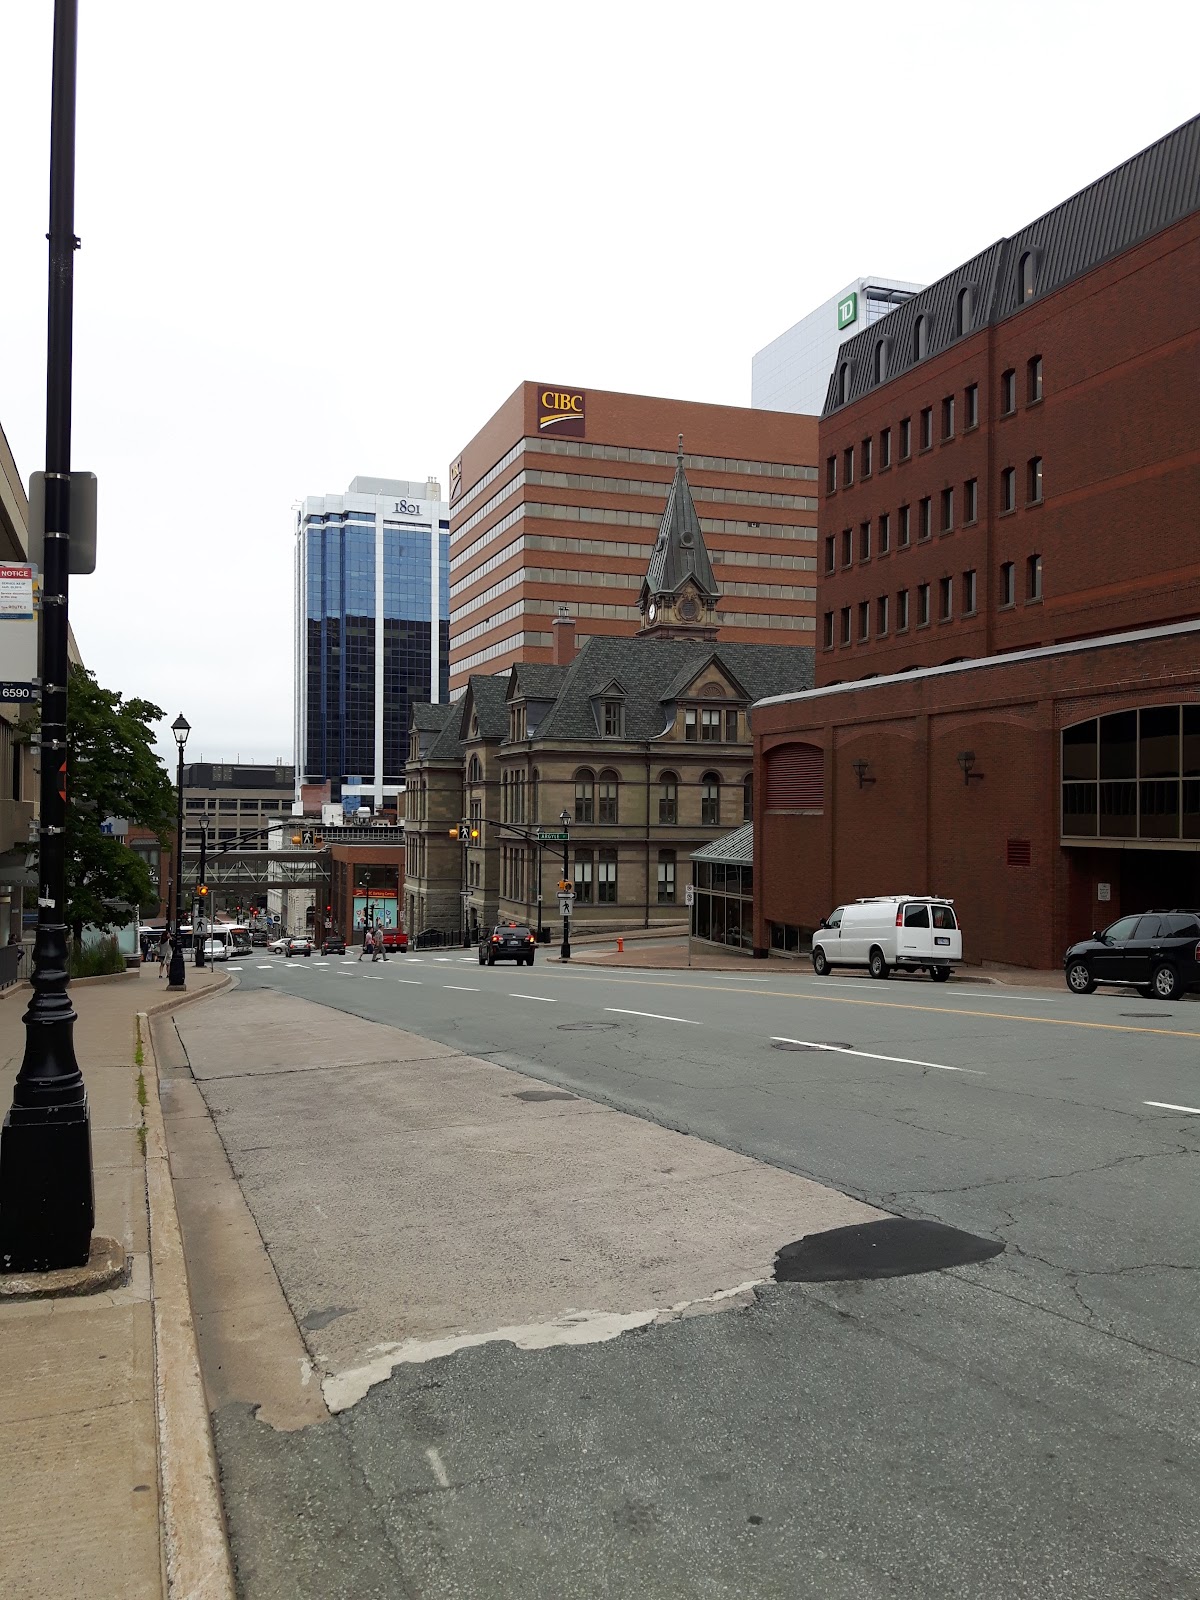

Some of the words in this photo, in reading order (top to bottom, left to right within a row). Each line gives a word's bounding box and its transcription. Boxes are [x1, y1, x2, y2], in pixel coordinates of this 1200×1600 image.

[840, 300, 853, 322] TD
[541, 391, 583, 412] CIBC
[394, 499, 421, 514] 1801
[2, 688, 30, 698] 6590
